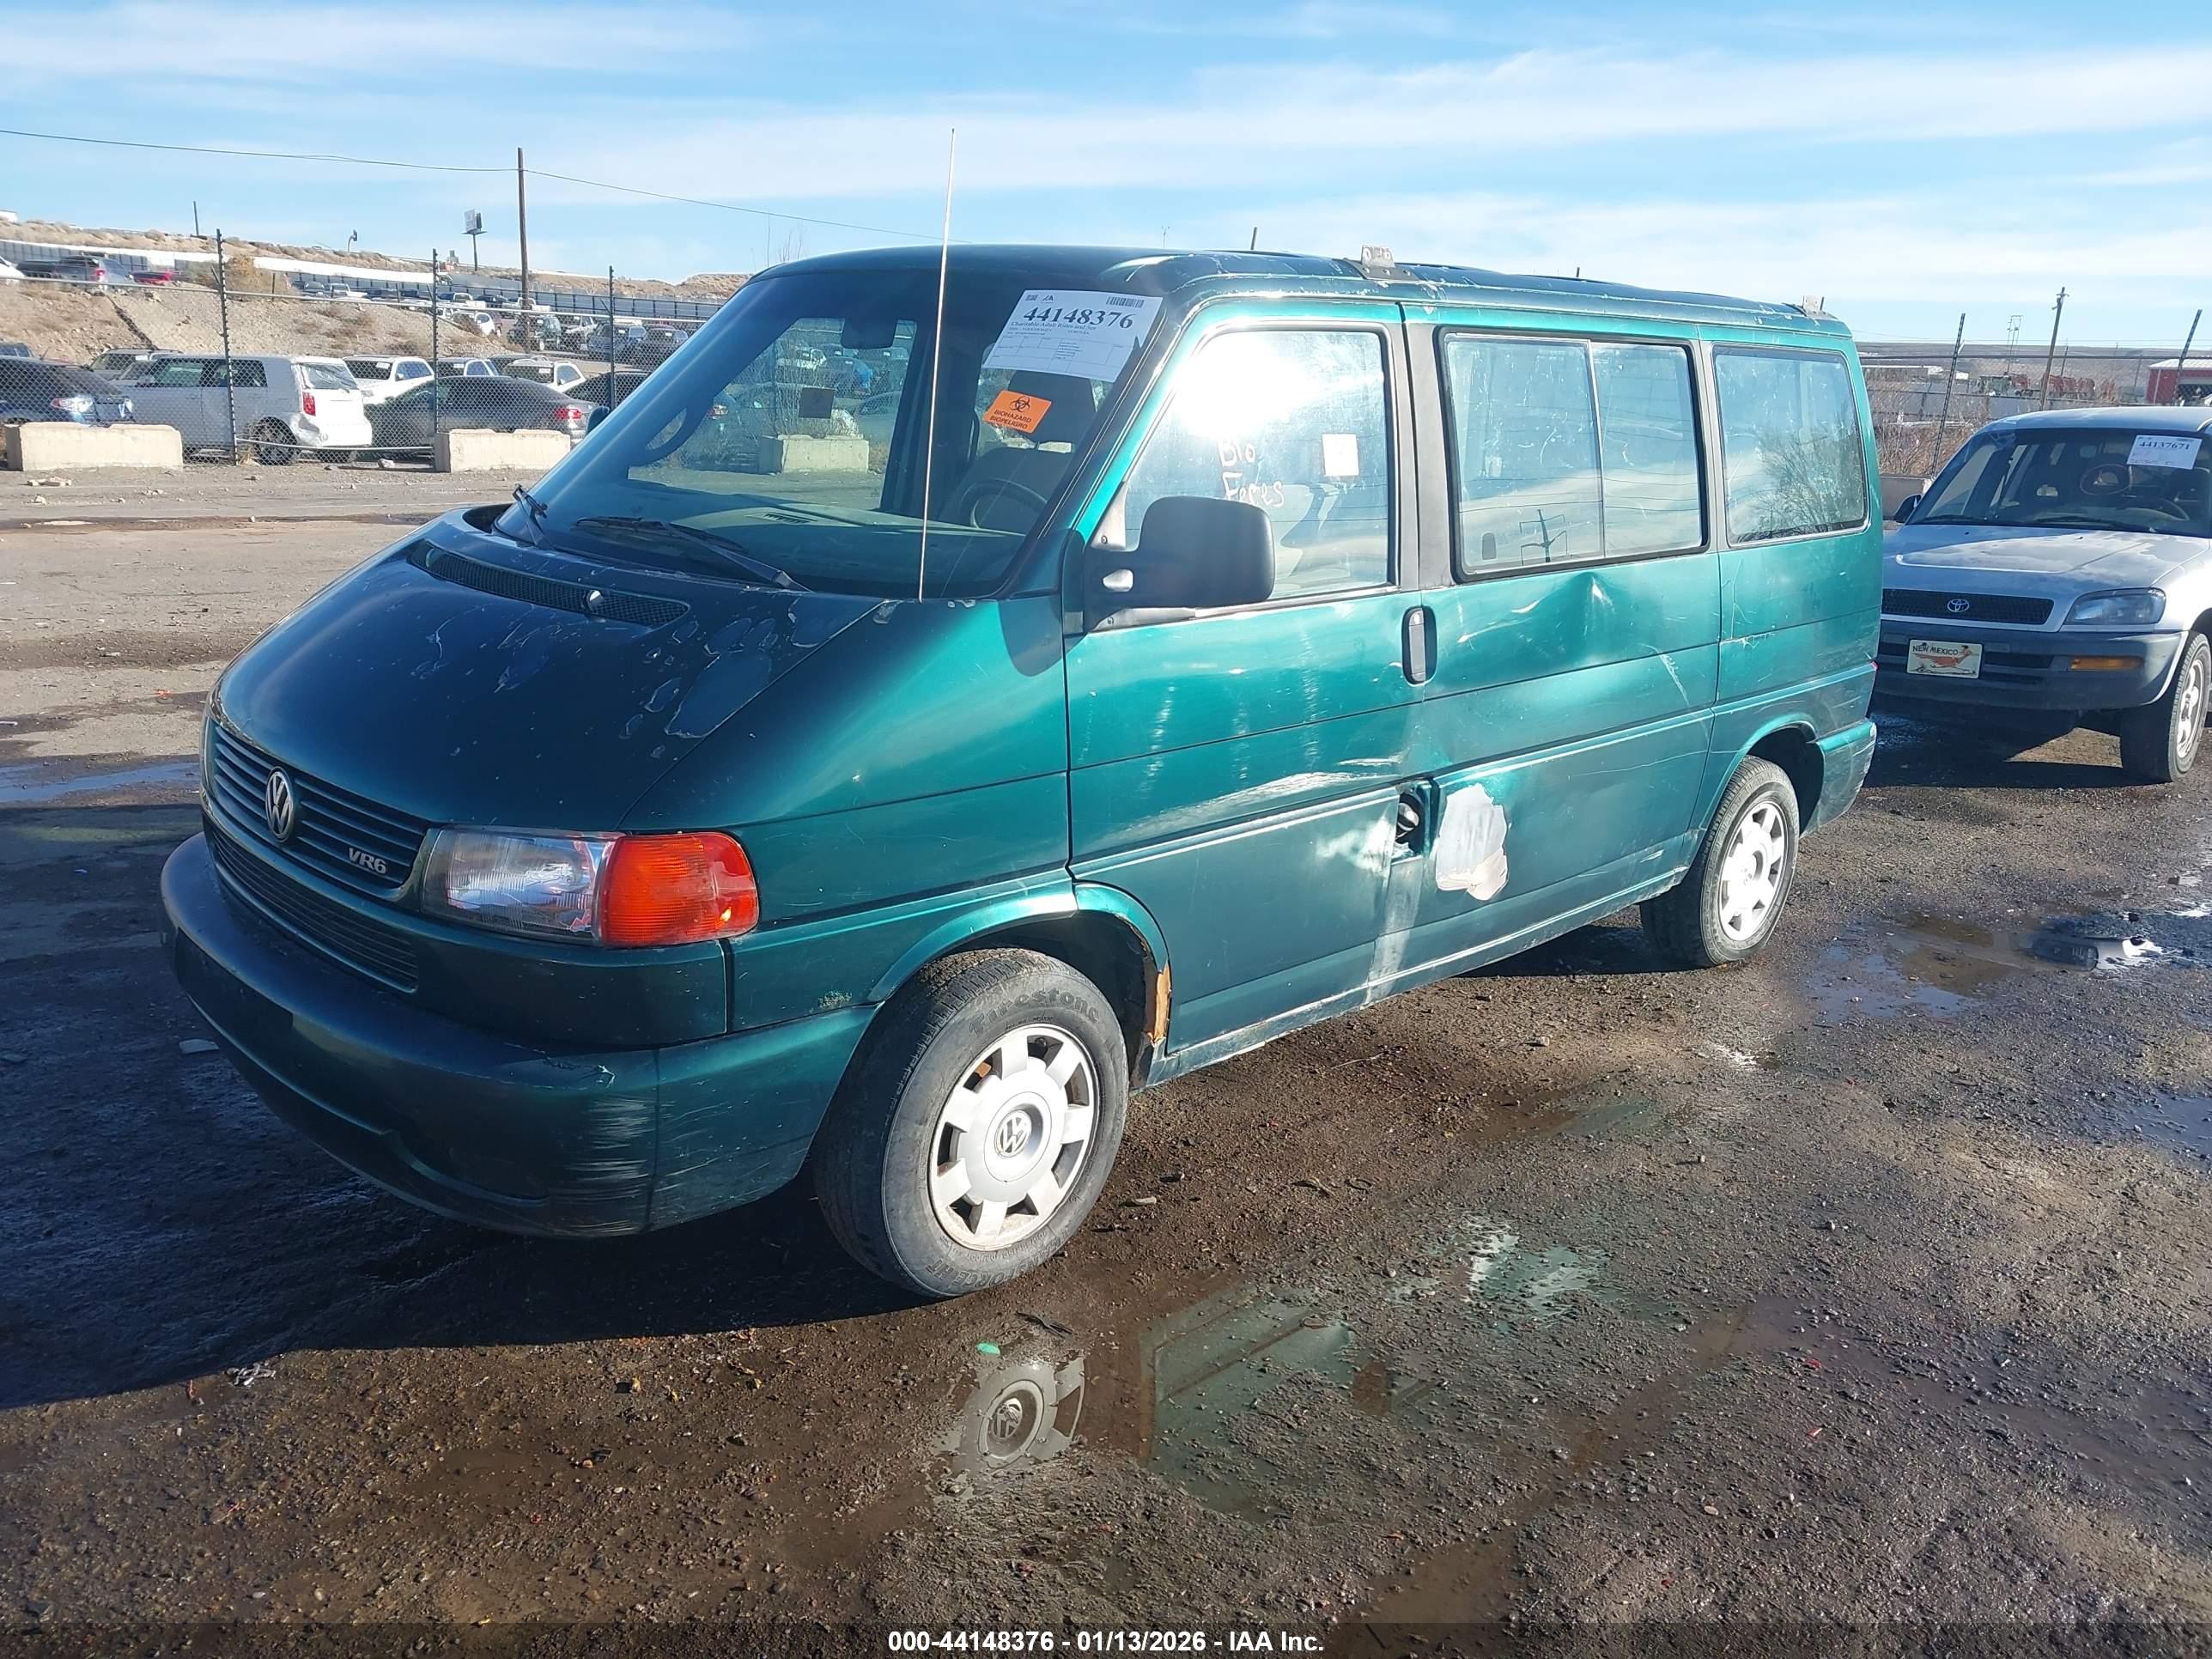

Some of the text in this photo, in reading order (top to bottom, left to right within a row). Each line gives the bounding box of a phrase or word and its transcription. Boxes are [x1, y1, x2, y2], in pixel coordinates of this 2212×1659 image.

[1024, 307, 1136, 329] 44148376
[989, 415, 1028, 429] BIOPELIGRO
[994, 409, 1032, 423] BIOHAZARD
[2139, 441, 2191, 450] 44137671
[1930, 647, 1959, 656] MEXICO
[349, 847, 387, 874] VR6
[969, 988, 1099, 1036] Firestone
